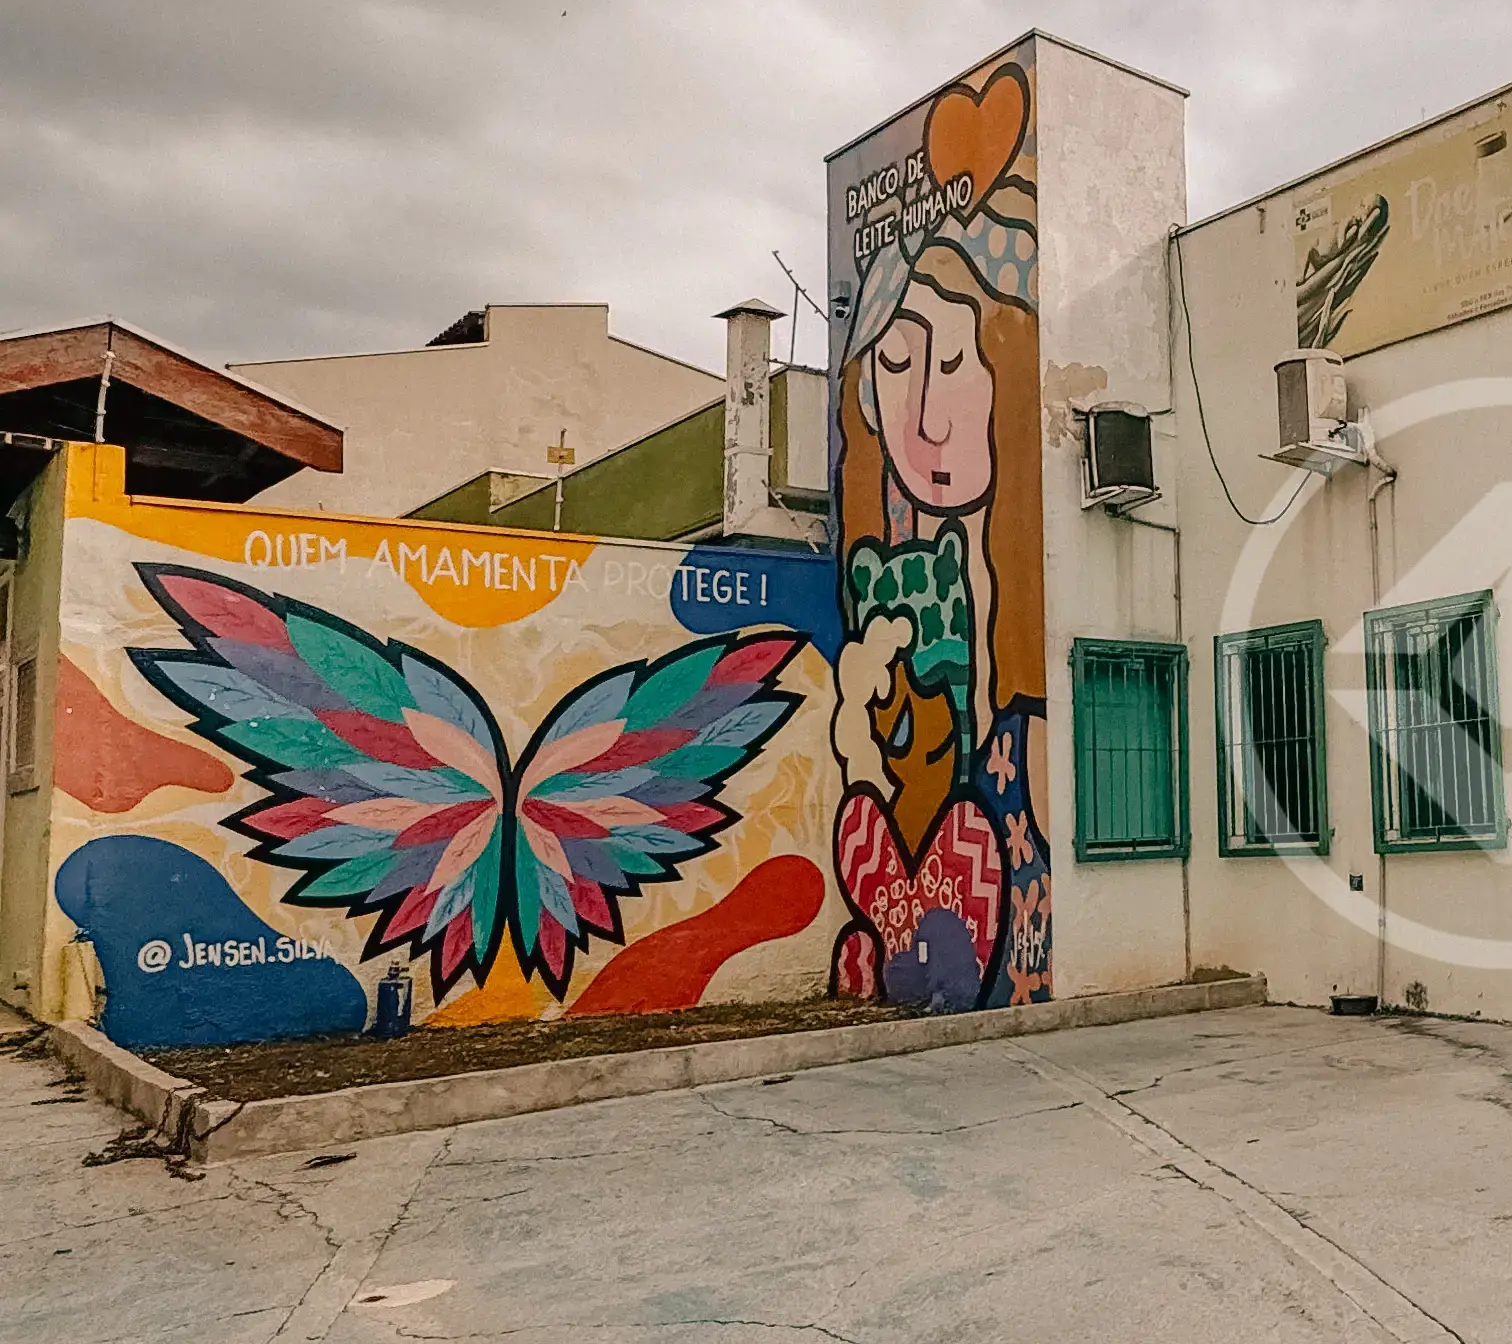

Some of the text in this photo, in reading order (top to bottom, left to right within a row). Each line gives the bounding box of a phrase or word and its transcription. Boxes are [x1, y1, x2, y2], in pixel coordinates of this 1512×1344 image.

[848, 151, 924, 218] BANCO DE
[855, 175, 972, 258] LEITE HUMANO
[244, 529, 347, 575] QUEM
[365, 539, 590, 594] AMAMENTA
[602, 560, 750, 605] PROTEGE
